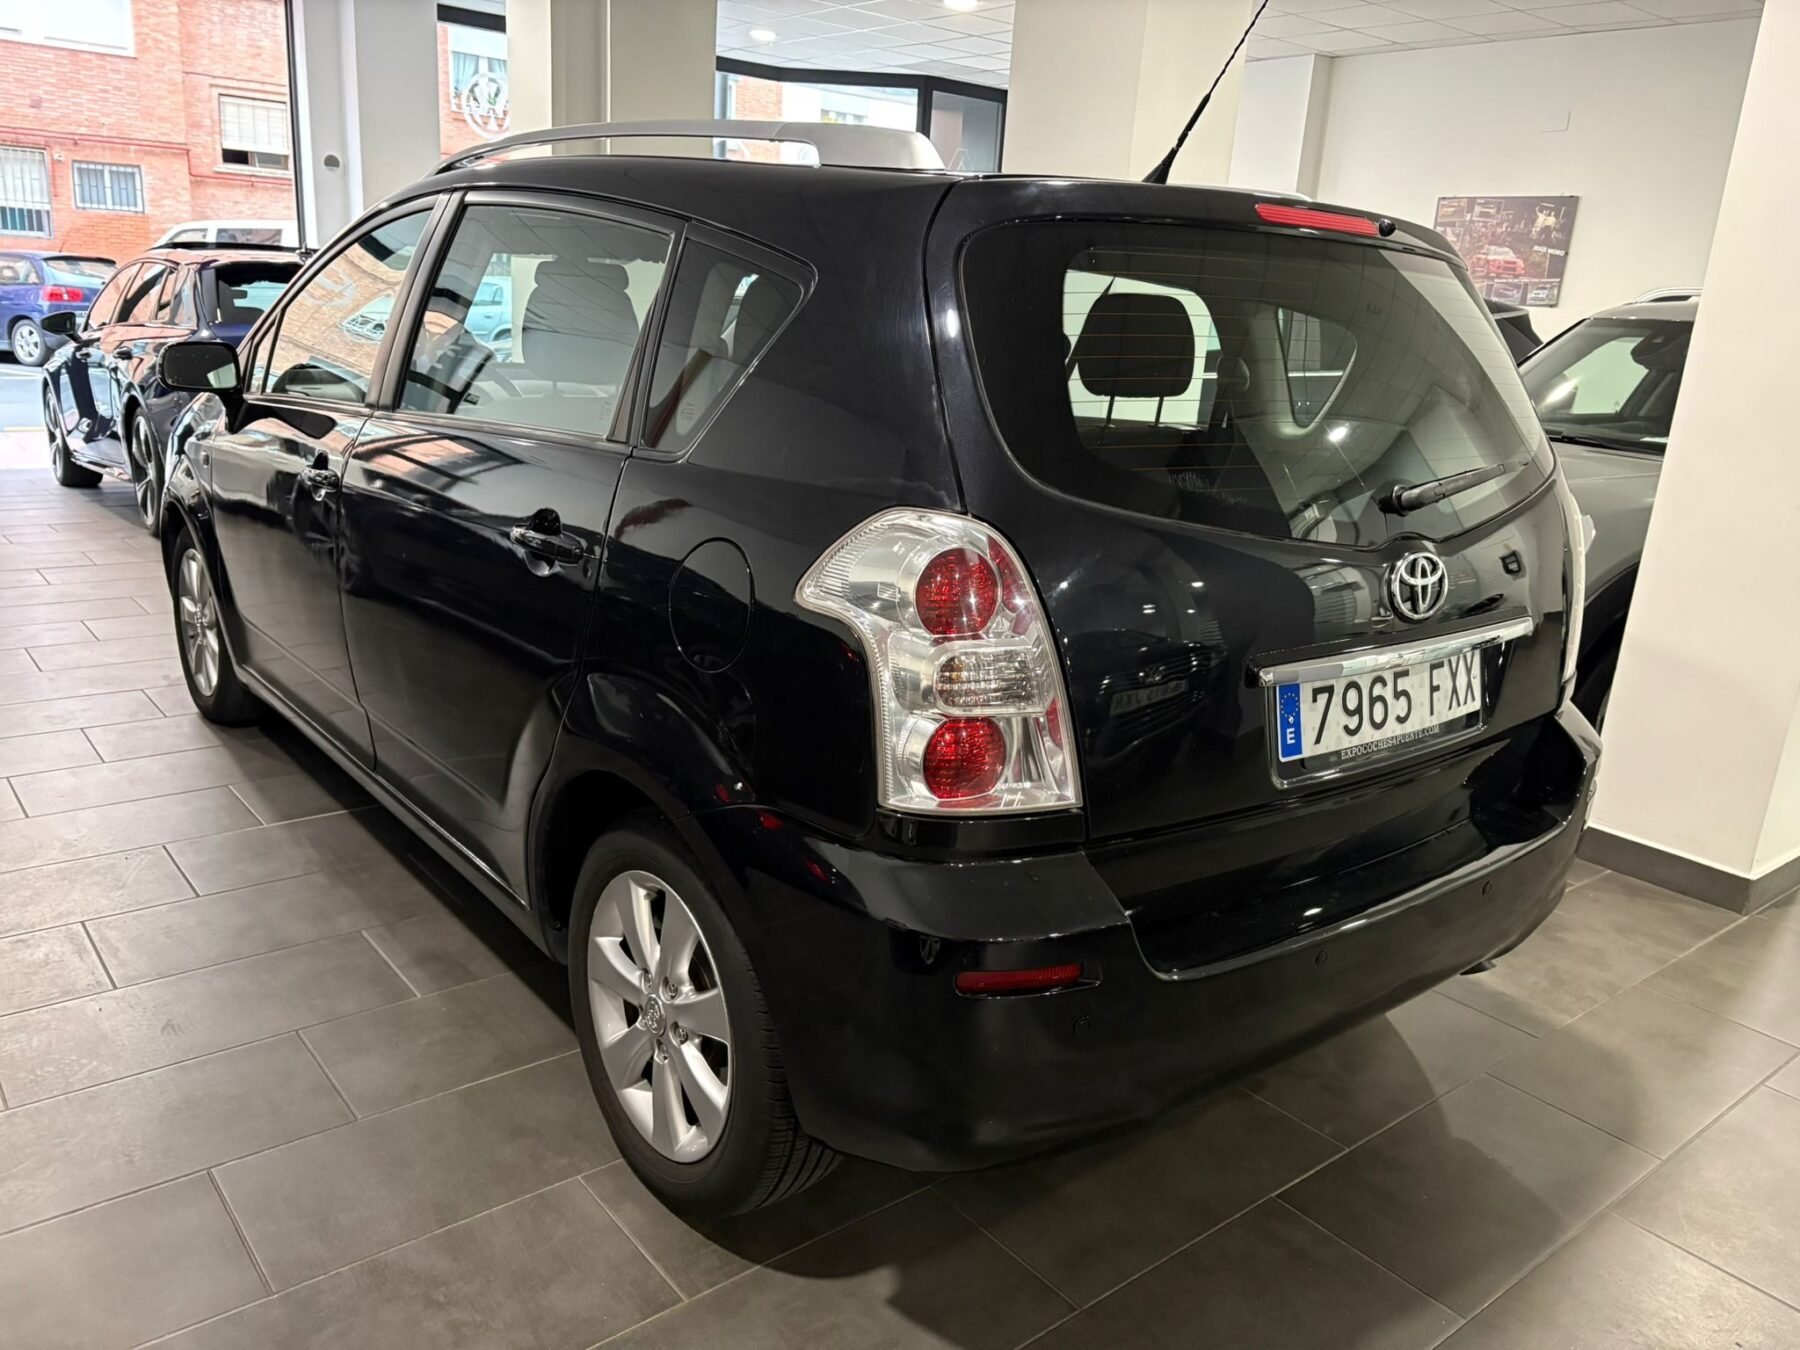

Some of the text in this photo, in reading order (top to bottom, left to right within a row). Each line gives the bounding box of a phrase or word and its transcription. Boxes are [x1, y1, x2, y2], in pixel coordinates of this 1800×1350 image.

[1311, 652, 1476, 745] 7965 FXX
[1286, 728, 1296, 744] E
